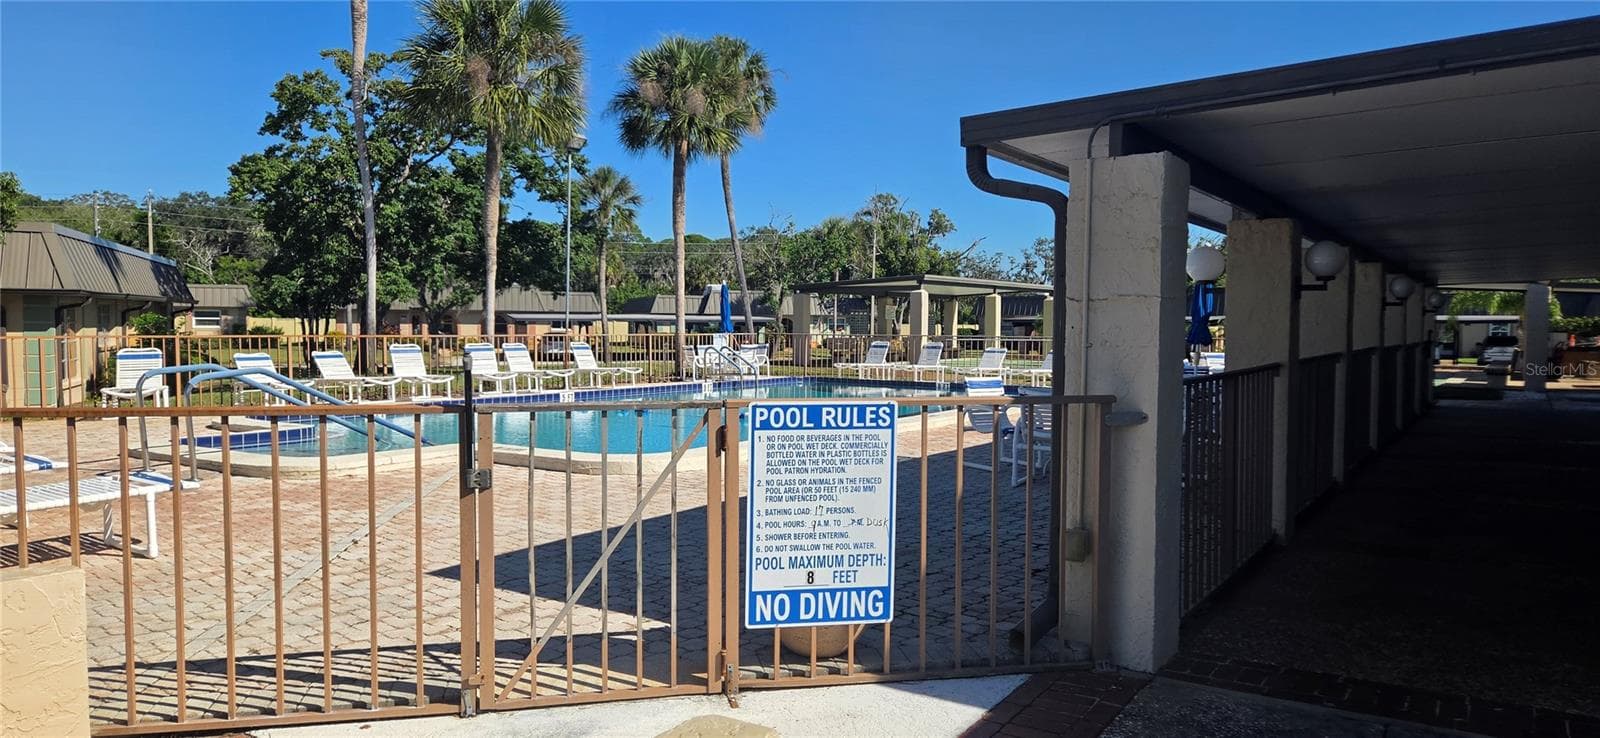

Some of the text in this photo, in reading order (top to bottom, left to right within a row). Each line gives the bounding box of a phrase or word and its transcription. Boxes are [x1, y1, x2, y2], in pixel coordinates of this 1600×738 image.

[756, 406, 890, 428] POOL RULES
[756, 558, 784, 570] POOL
[789, 555, 844, 569] MAXIMUM
[807, 570, 858, 584] 8 FEET
[756, 590, 883, 622] NO DIVING
